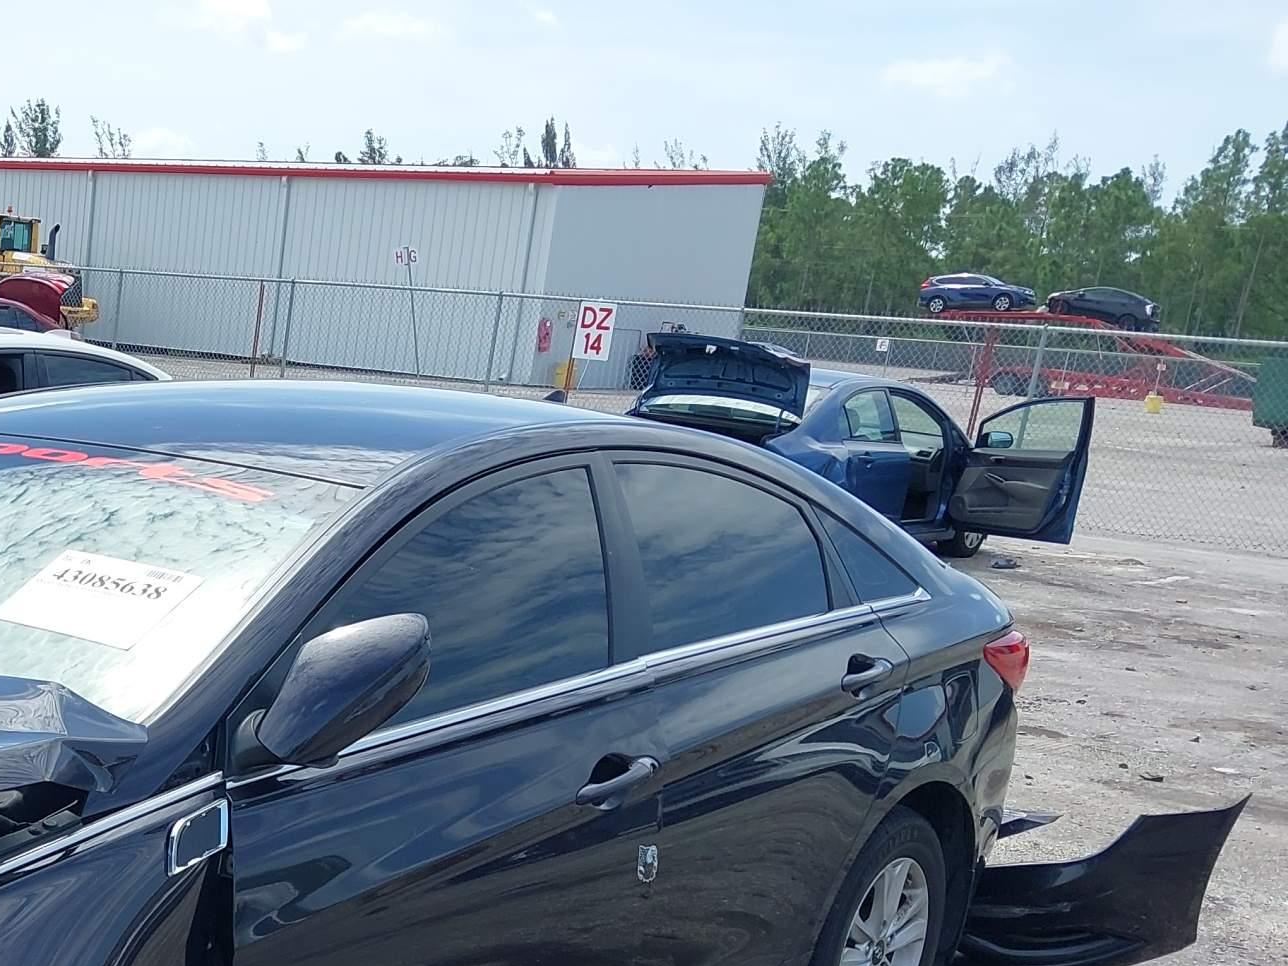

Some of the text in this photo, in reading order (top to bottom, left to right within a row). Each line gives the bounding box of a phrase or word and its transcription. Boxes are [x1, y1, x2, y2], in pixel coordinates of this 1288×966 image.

[395, 250, 404, 264] H
[409, 249, 417, 263] G
[580, 306, 613, 331] DZ
[583, 332, 602, 356] 14
[52, 568, 168, 600] 43085638
